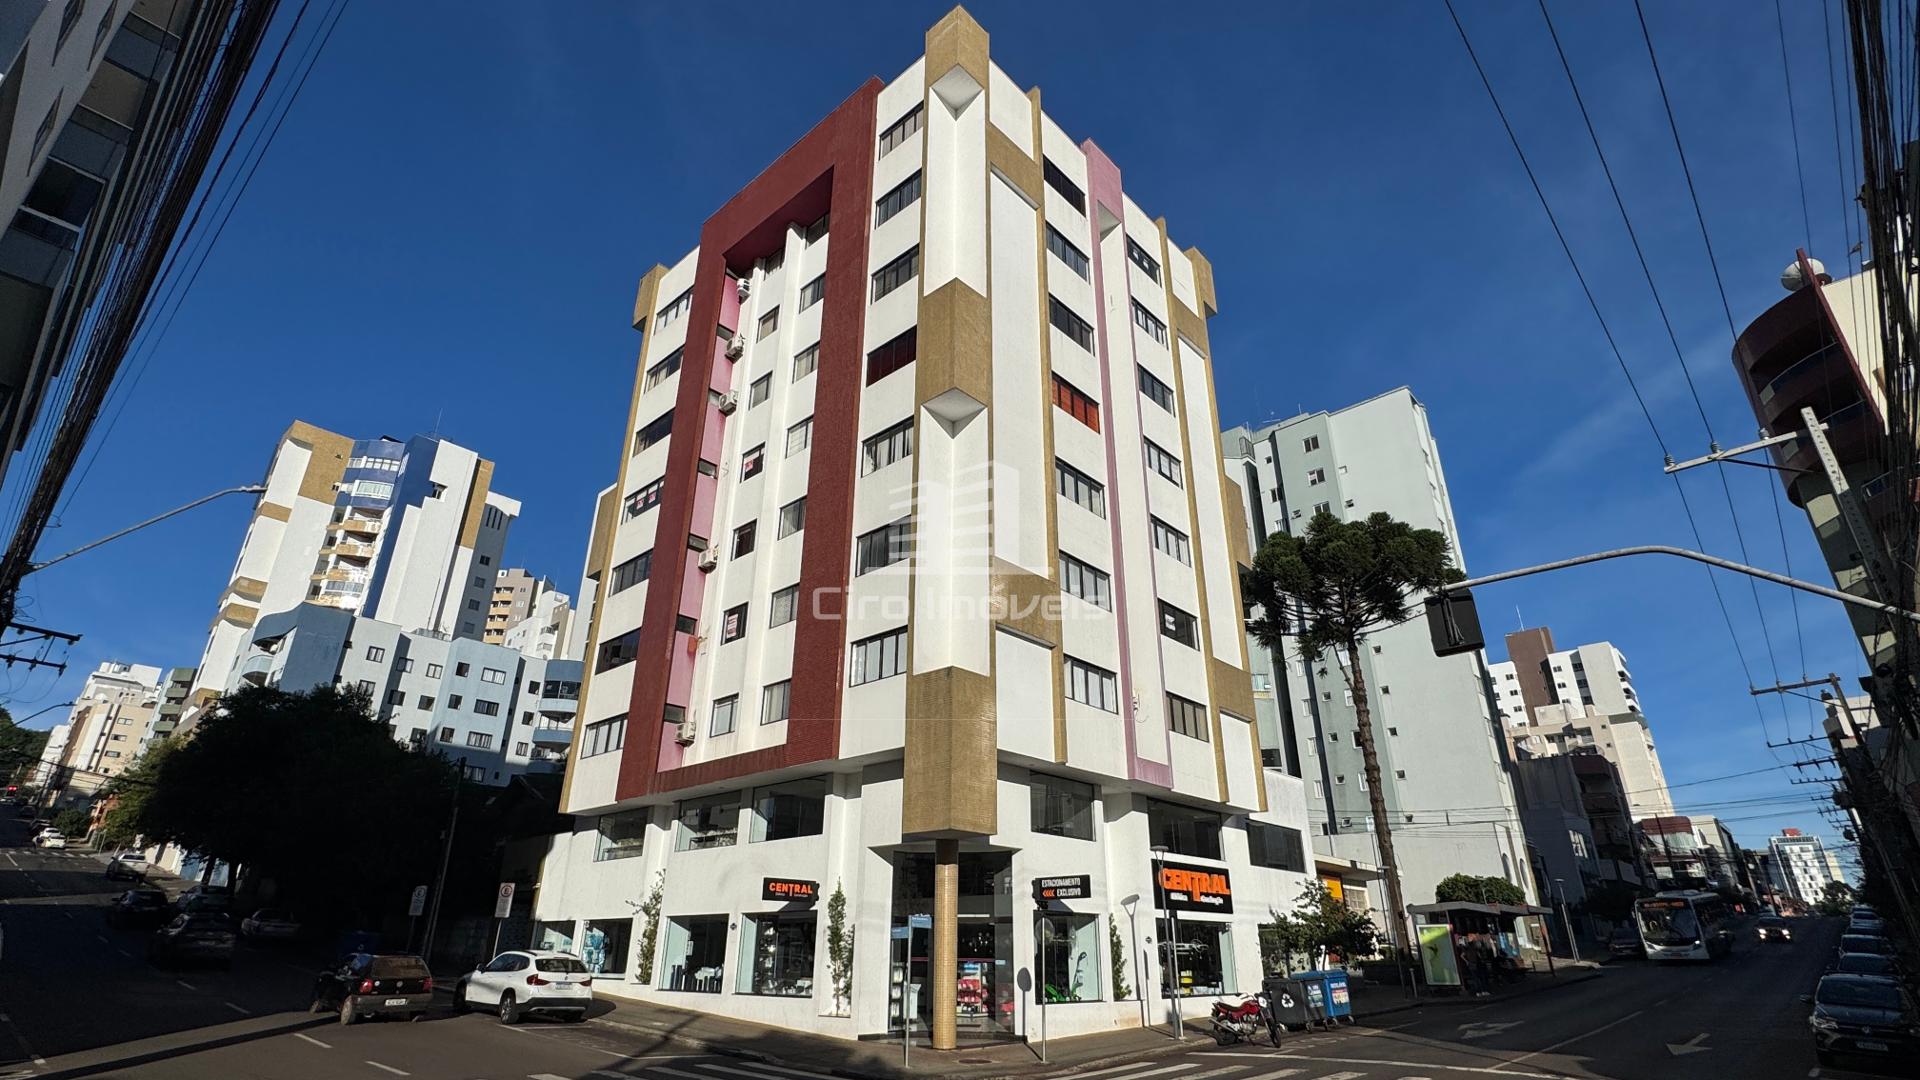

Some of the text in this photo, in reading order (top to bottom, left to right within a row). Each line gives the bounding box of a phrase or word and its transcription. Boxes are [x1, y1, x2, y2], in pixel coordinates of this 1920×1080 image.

[1041, 877, 1081, 888] ESTACIONAMENTO
[1158, 868, 1232, 902] CENTRAL
[769, 882, 813, 897] CENTRAL
[1056, 887, 1081, 897] EXCLUSIVO
